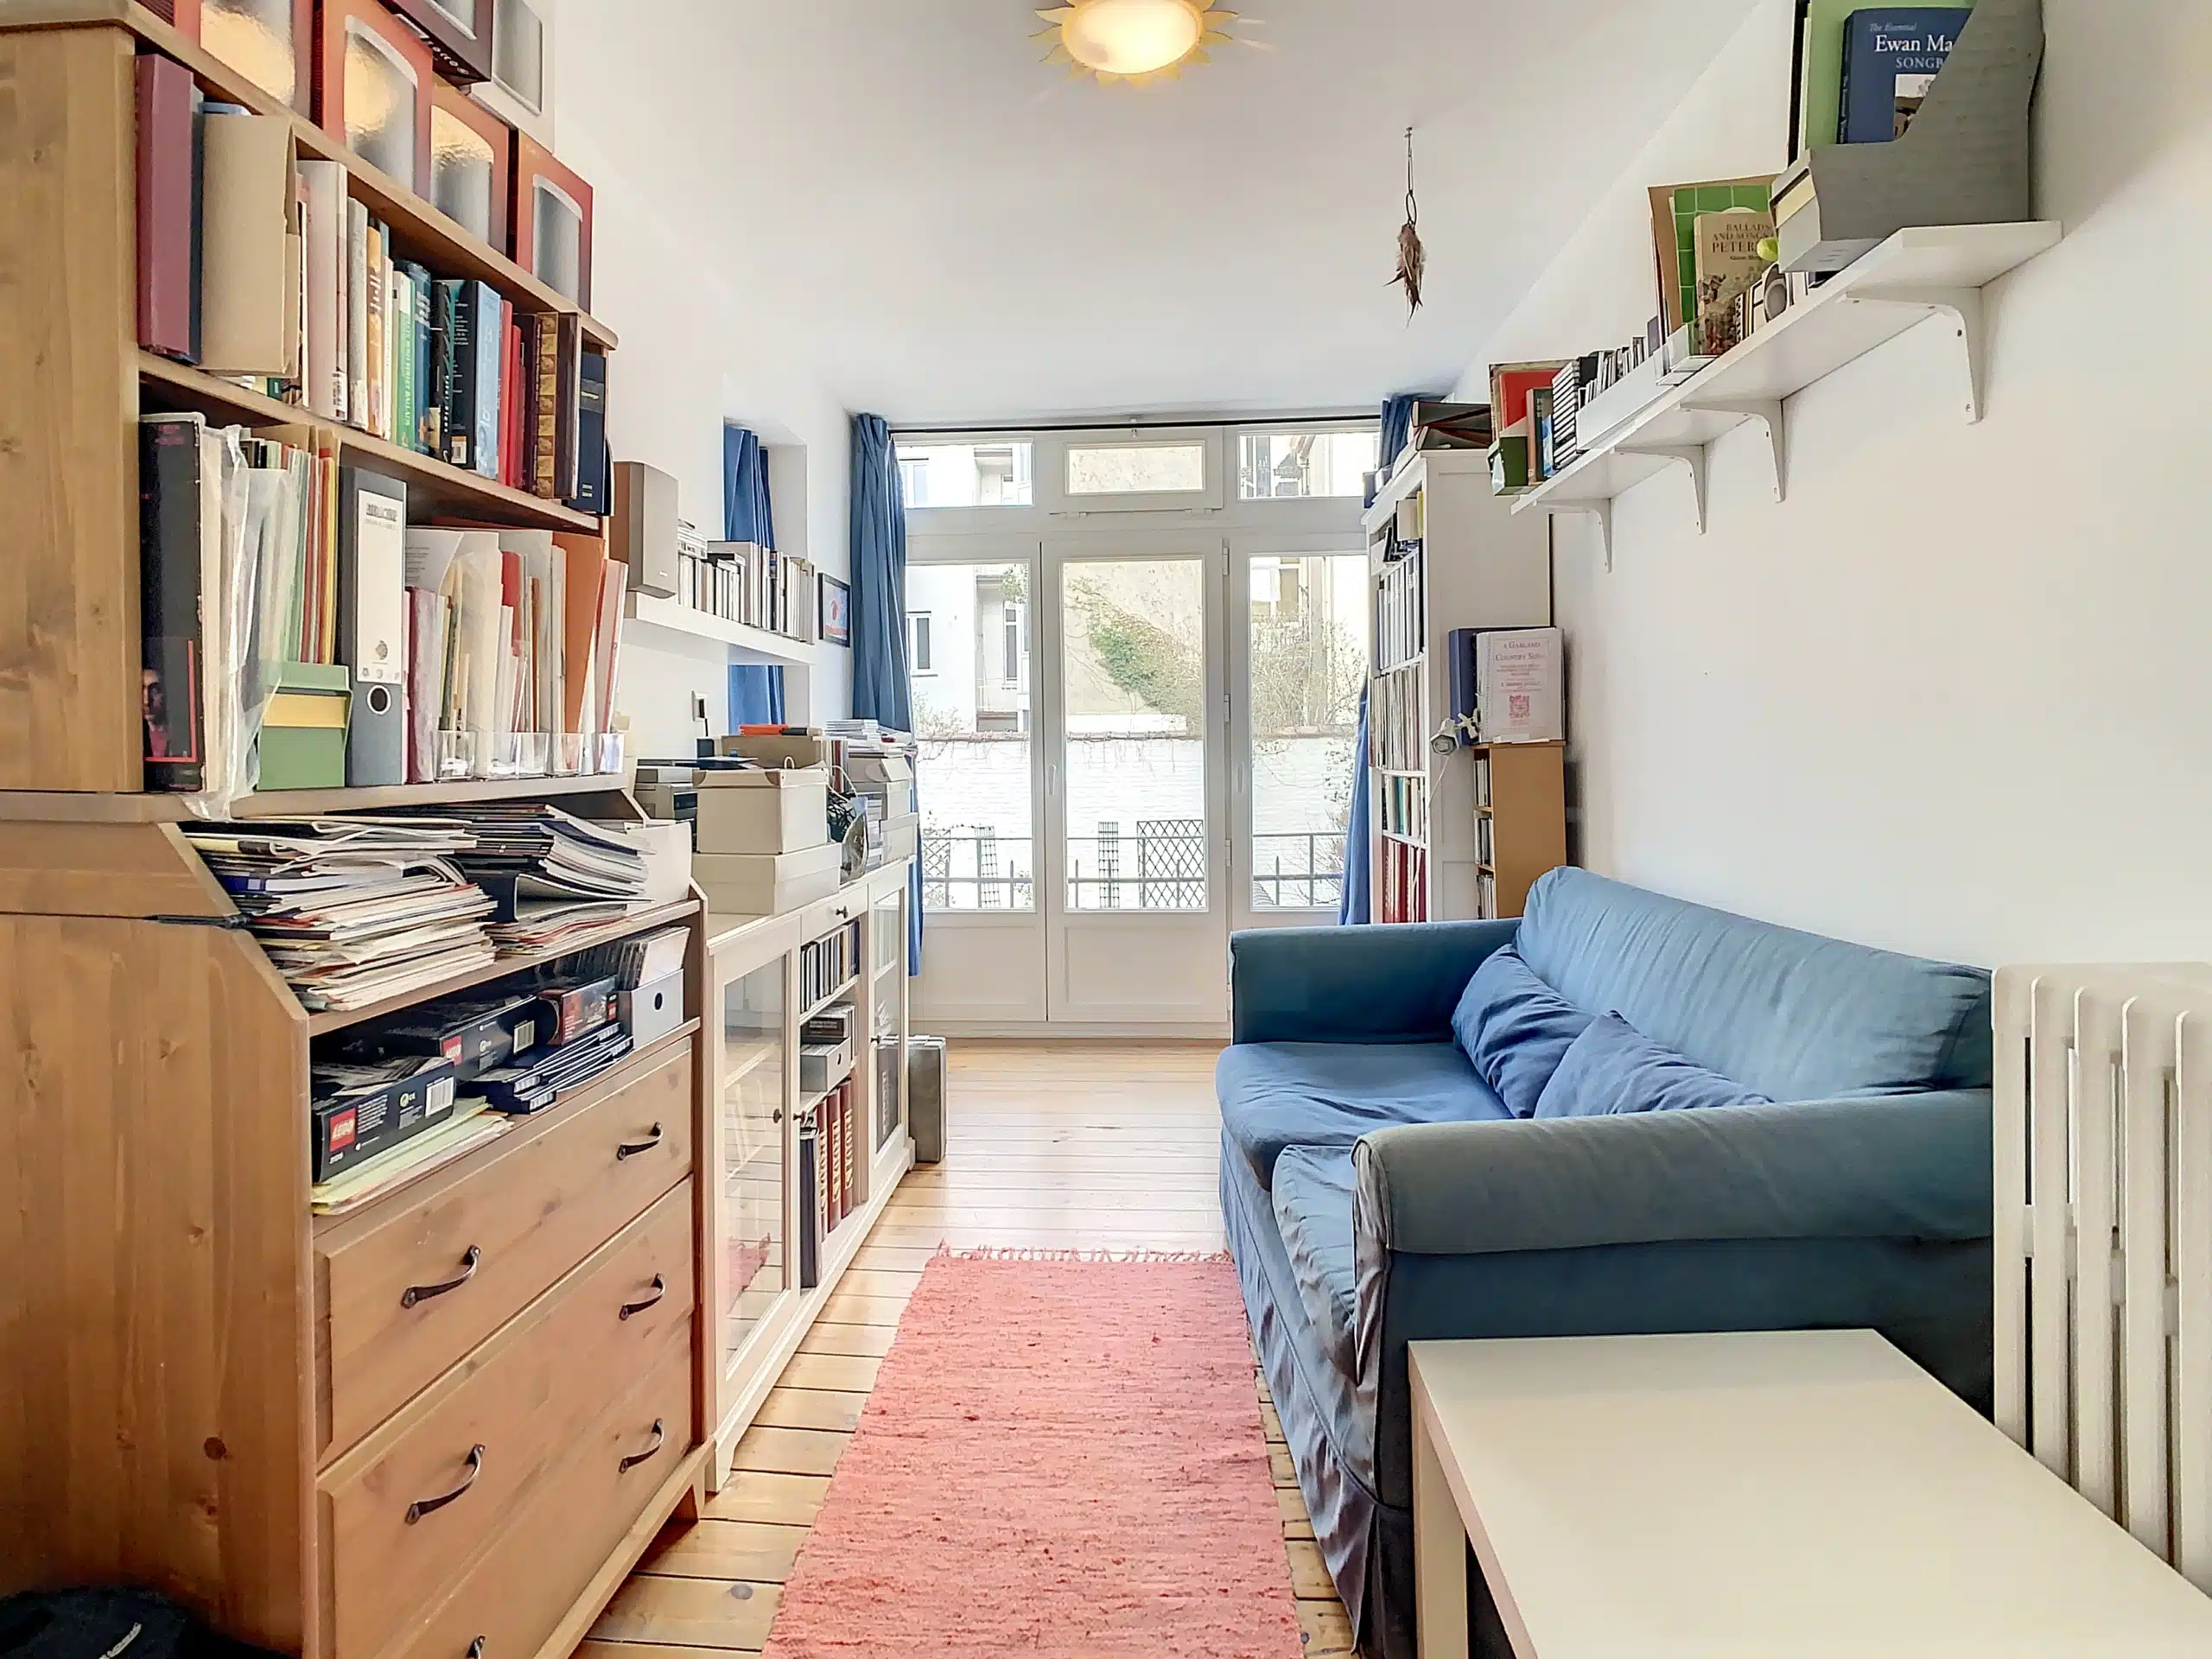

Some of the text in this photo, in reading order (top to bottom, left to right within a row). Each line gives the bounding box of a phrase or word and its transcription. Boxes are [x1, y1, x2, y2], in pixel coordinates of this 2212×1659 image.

[1874, 34, 1921, 53] Ewan
[1713, 232, 1733, 241] AND
[1712, 241, 1757, 253] PETER
